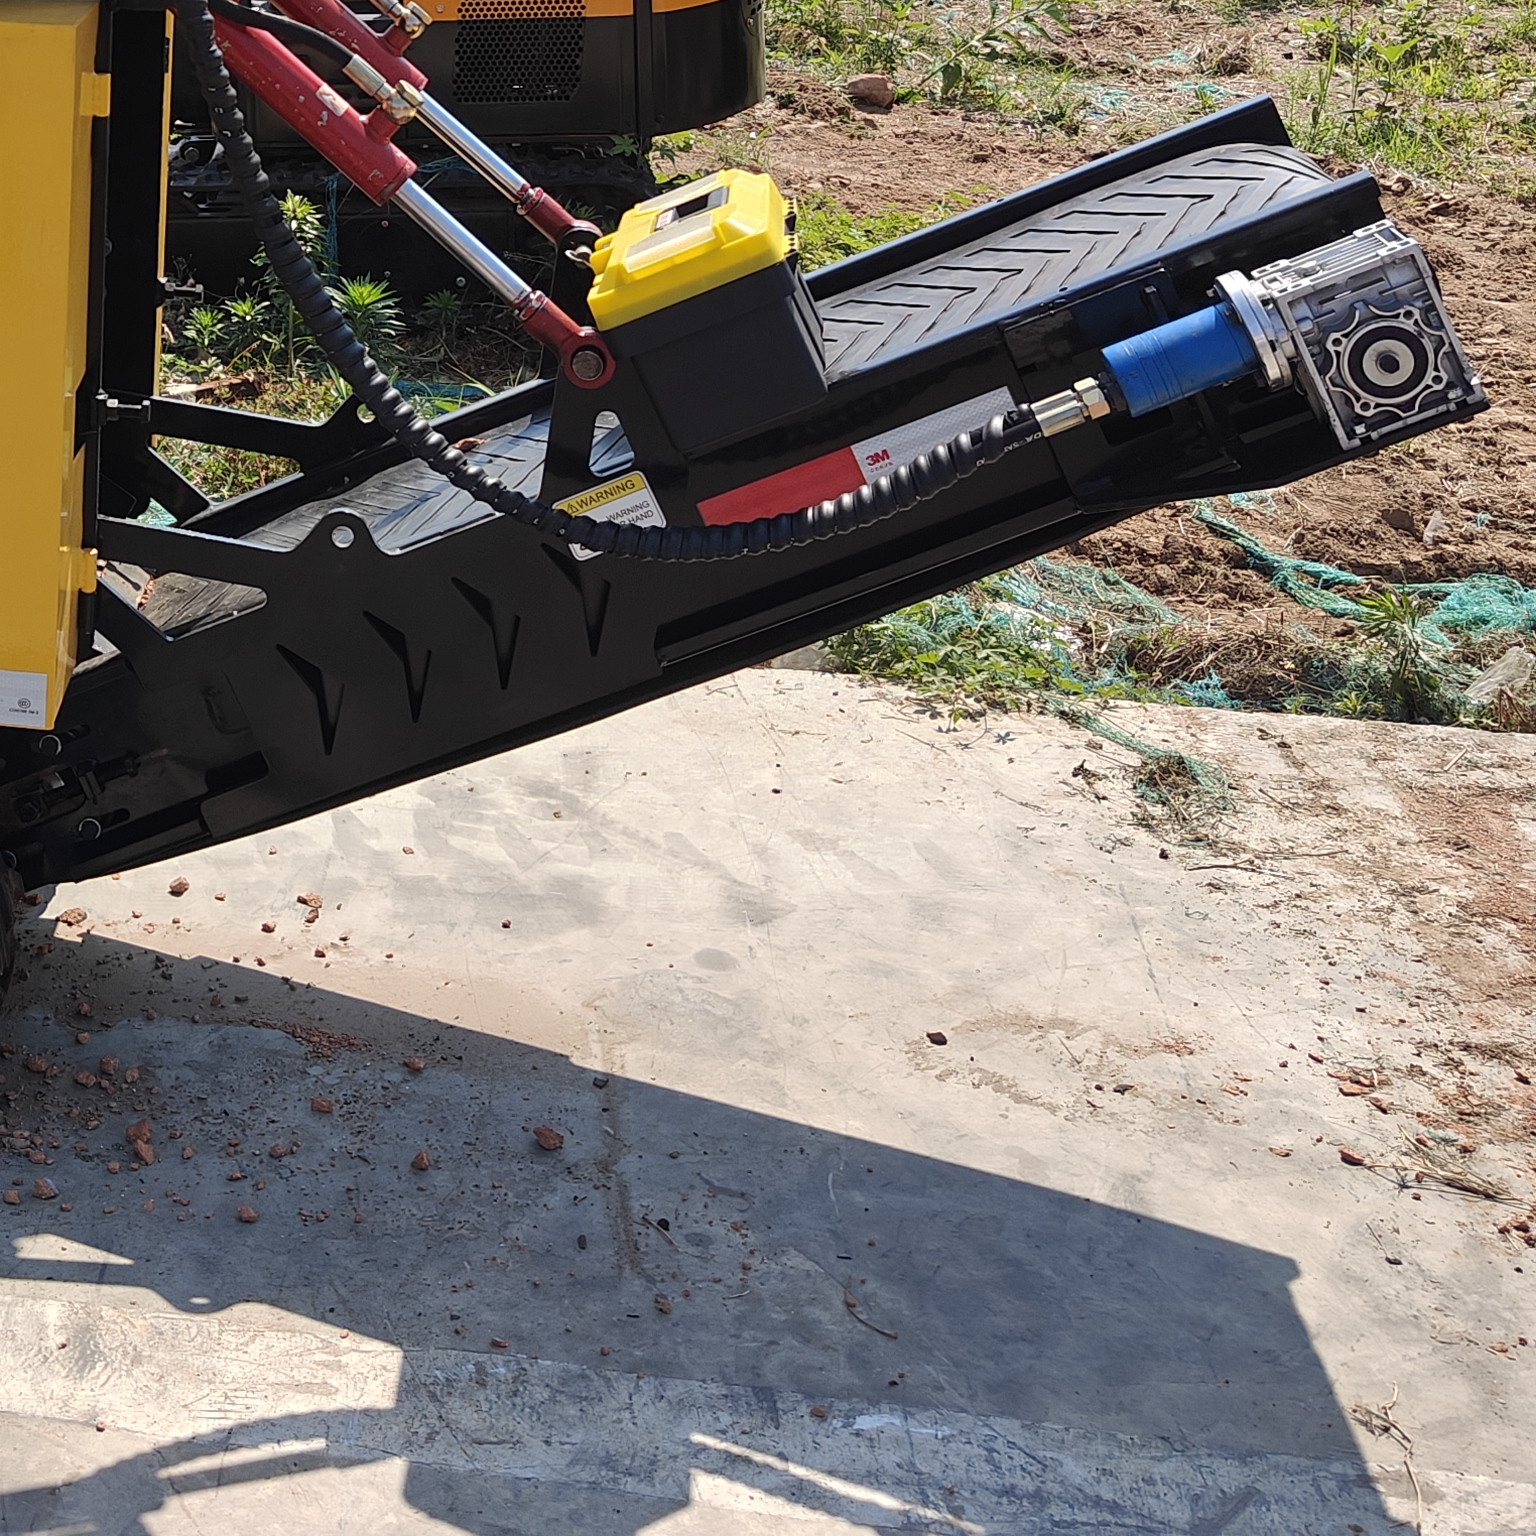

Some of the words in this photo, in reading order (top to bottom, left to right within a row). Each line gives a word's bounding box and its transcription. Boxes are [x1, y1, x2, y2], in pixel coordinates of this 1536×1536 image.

[865, 449, 890, 466] 3M
[576, 479, 636, 509] WARNING
[606, 500, 651, 521] WARNING
[628, 509, 655, 524] HAND
